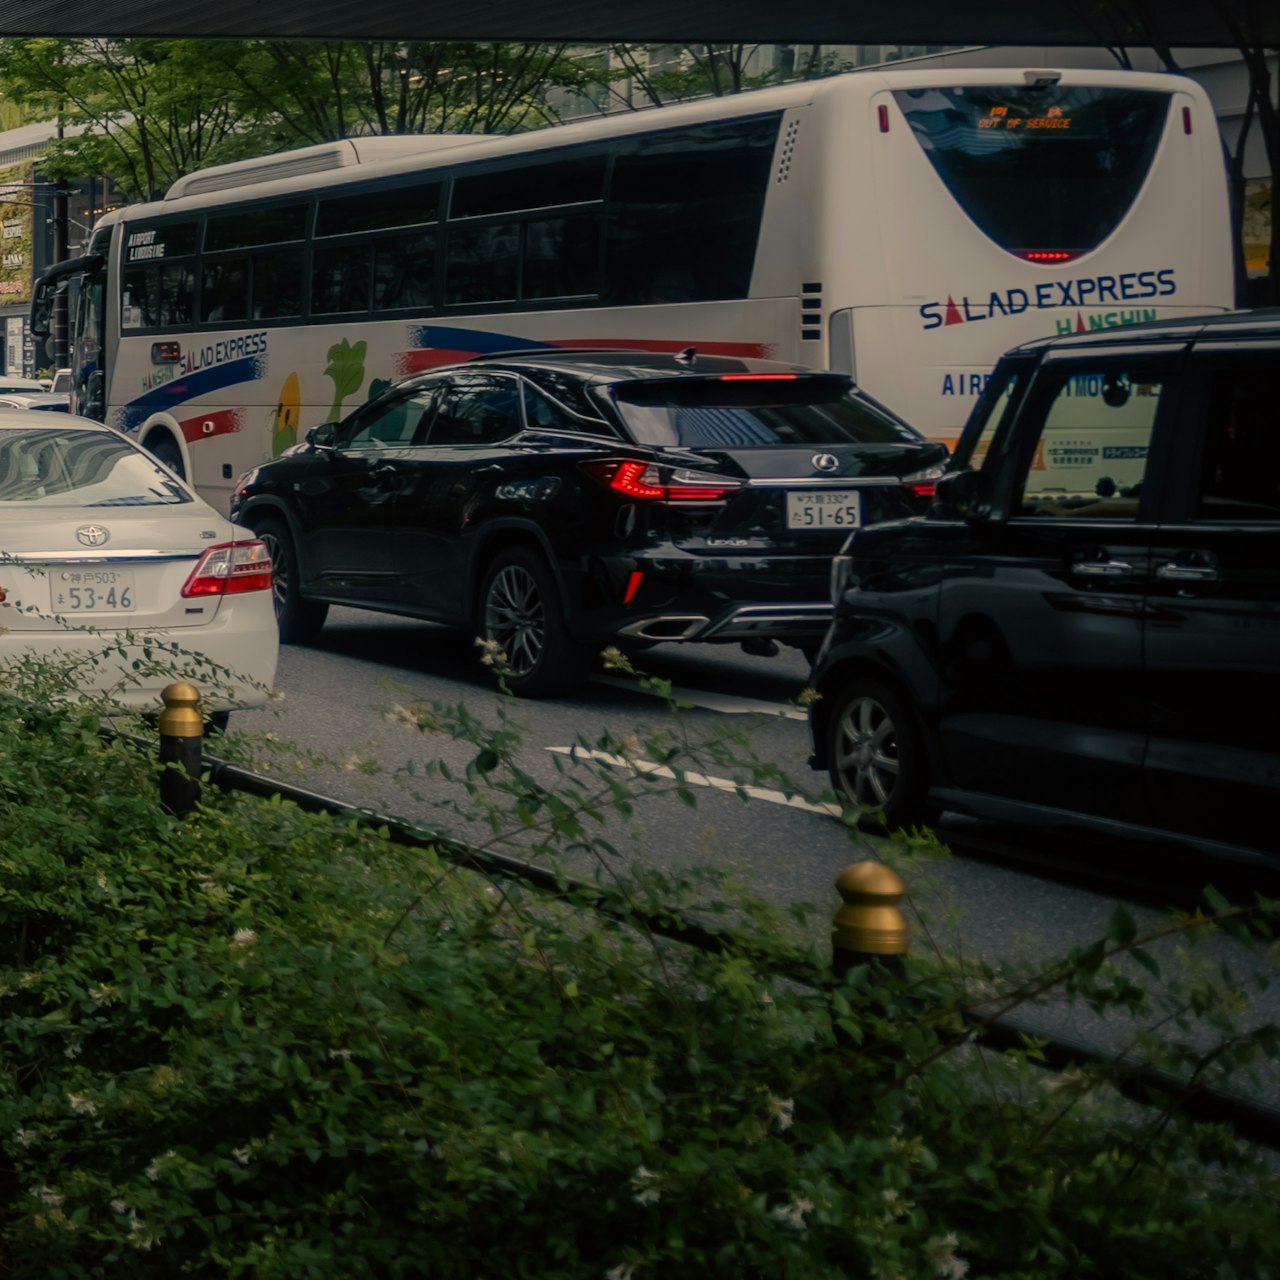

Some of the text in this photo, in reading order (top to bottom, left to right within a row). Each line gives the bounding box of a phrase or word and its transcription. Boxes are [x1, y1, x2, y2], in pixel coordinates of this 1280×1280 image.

[1026, 118, 1072, 129] SERVICE
[128, 230, 157, 248] AIRPORT
[129, 243, 166, 261] LIMOUSINE
[919, 268, 1177, 330] SALAD EXPRESS
[1055, 308, 1157, 335] HANSHIN
[179, 346, 214, 376] SALAD
[215, 332, 268, 364] EXPRESS
[804, 506, 856, 526] 51-65
[69, 586, 132, 609] 53-46
